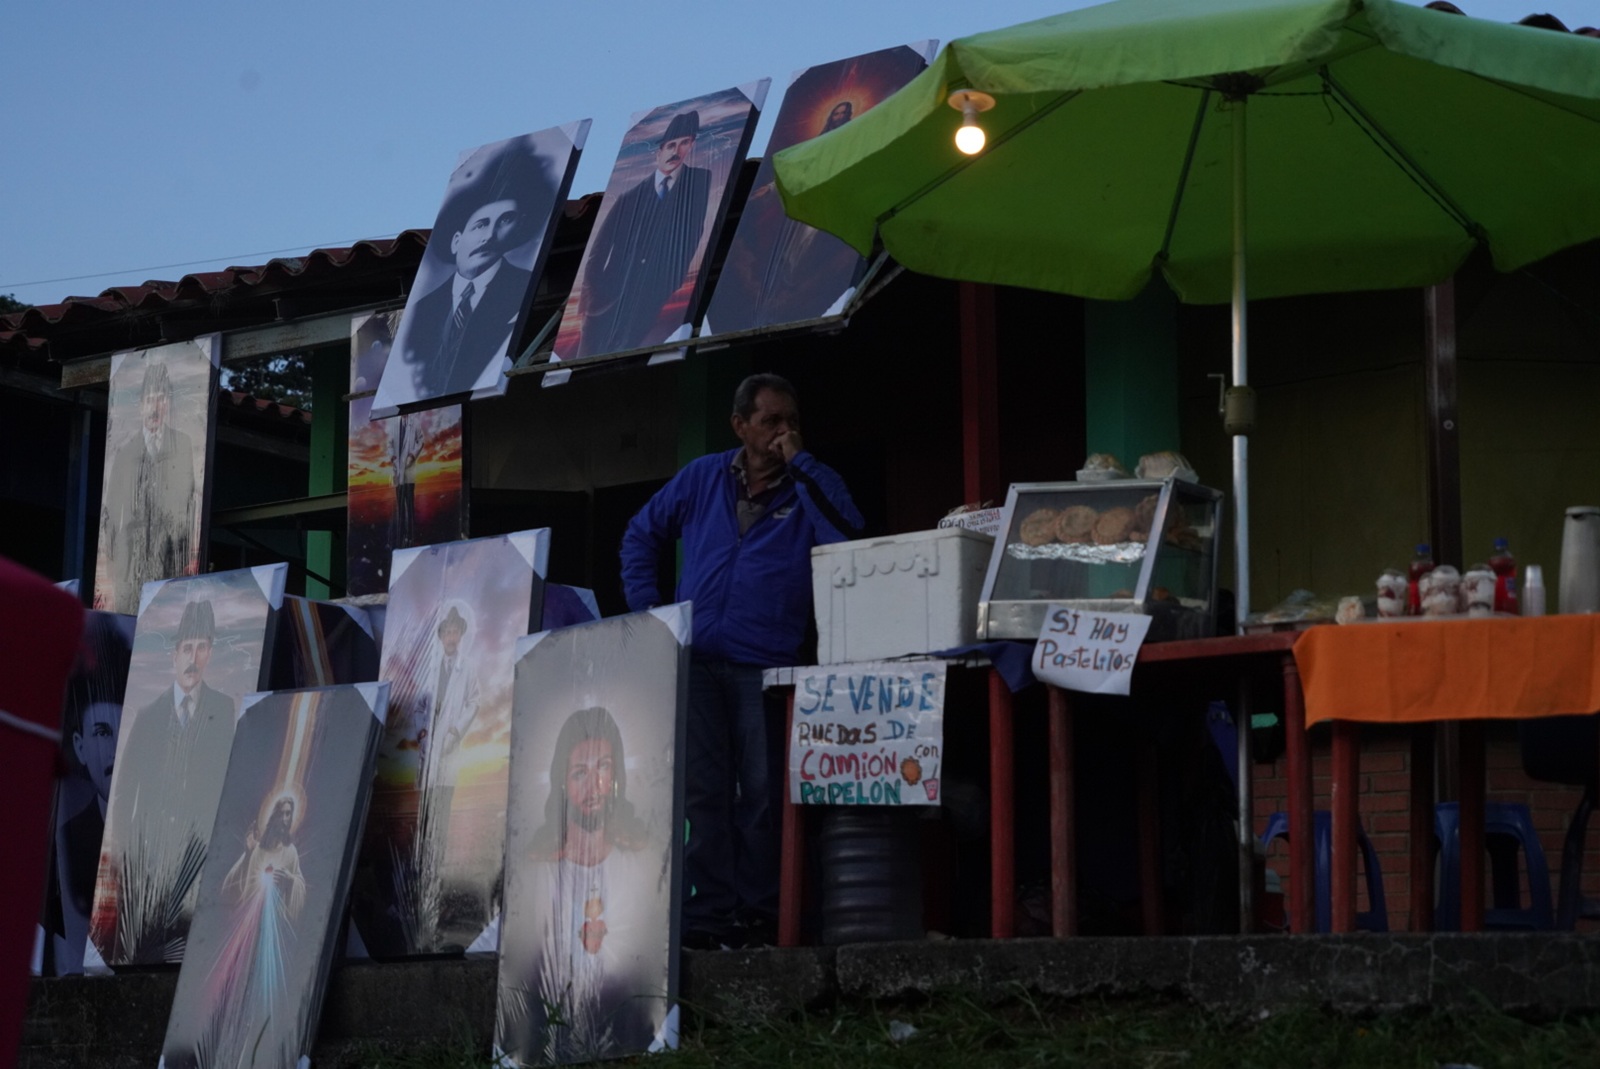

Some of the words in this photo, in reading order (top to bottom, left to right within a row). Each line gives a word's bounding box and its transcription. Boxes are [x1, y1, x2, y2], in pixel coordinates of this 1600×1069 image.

[1049, 609, 1080, 635] SI
[1089, 617, 1129, 643] Hay
[800, 674, 836, 715] SE
[848, 673, 936, 715] VENDE
[882, 720, 916, 741] DE
